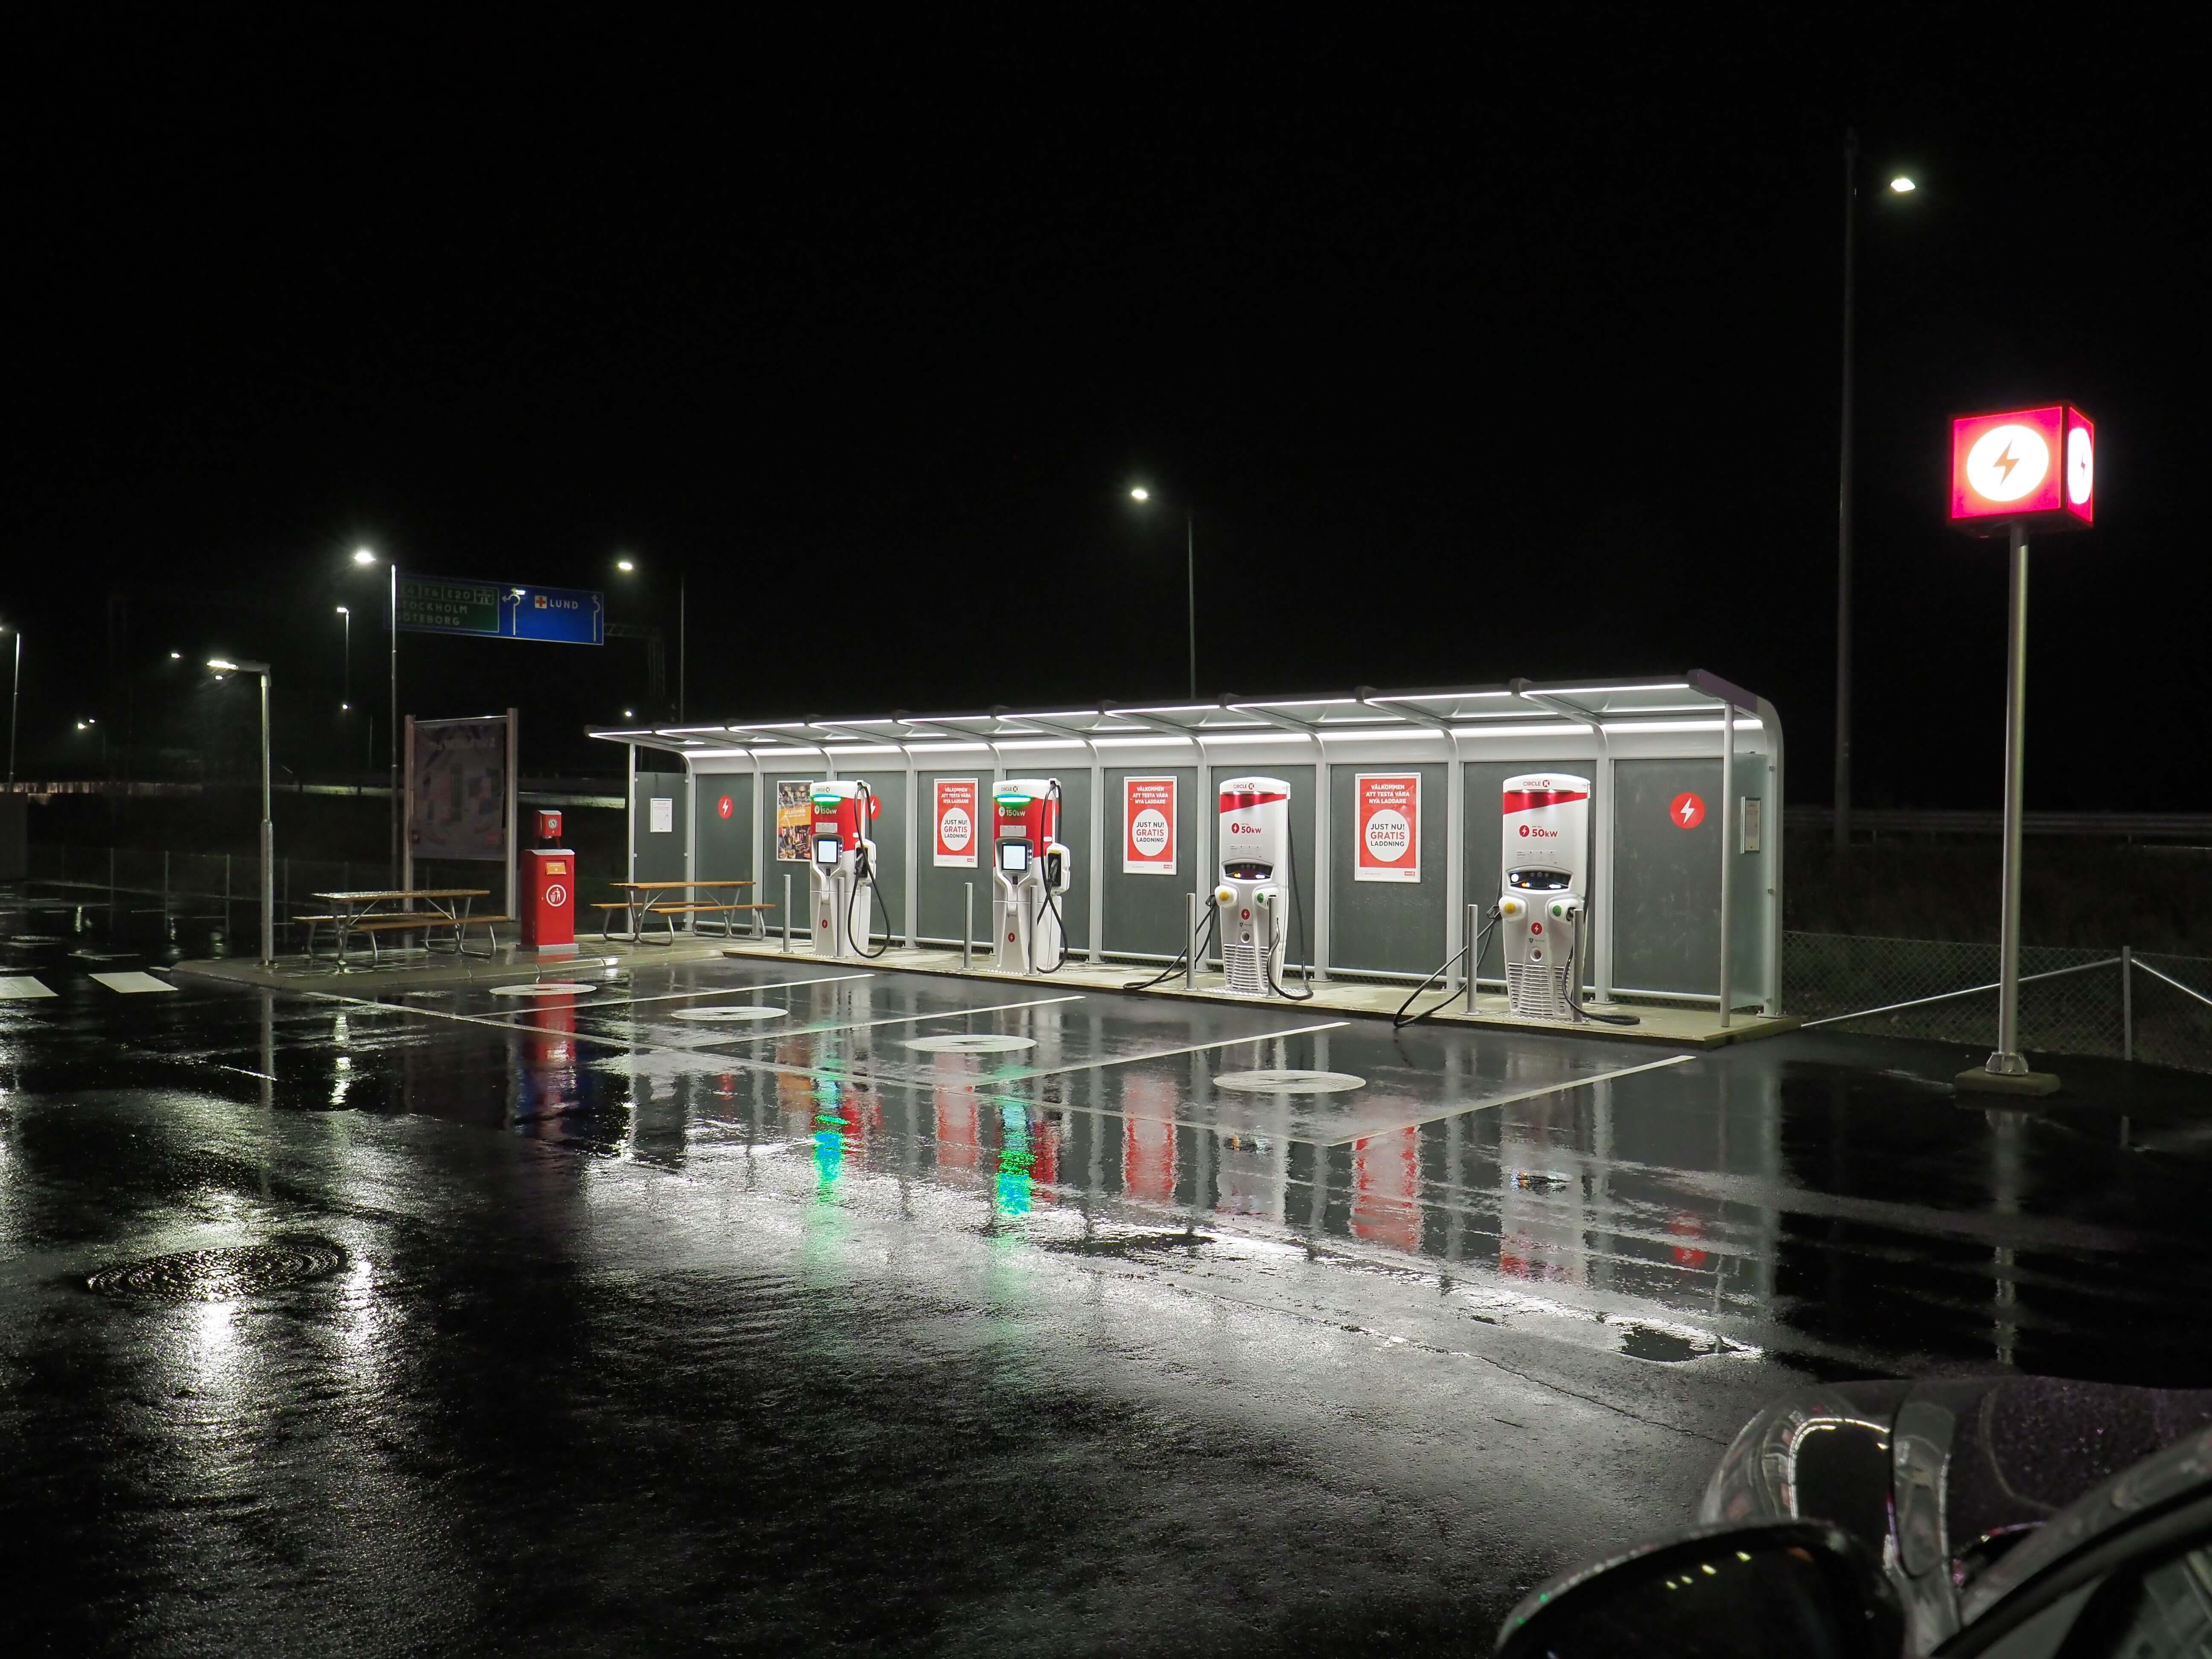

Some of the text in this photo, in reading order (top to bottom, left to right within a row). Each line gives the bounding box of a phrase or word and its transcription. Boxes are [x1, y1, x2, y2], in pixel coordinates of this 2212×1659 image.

[447, 589, 470, 600] E20
[550, 599, 578, 609] LUND
[1532, 829, 1557, 837] 50kW
